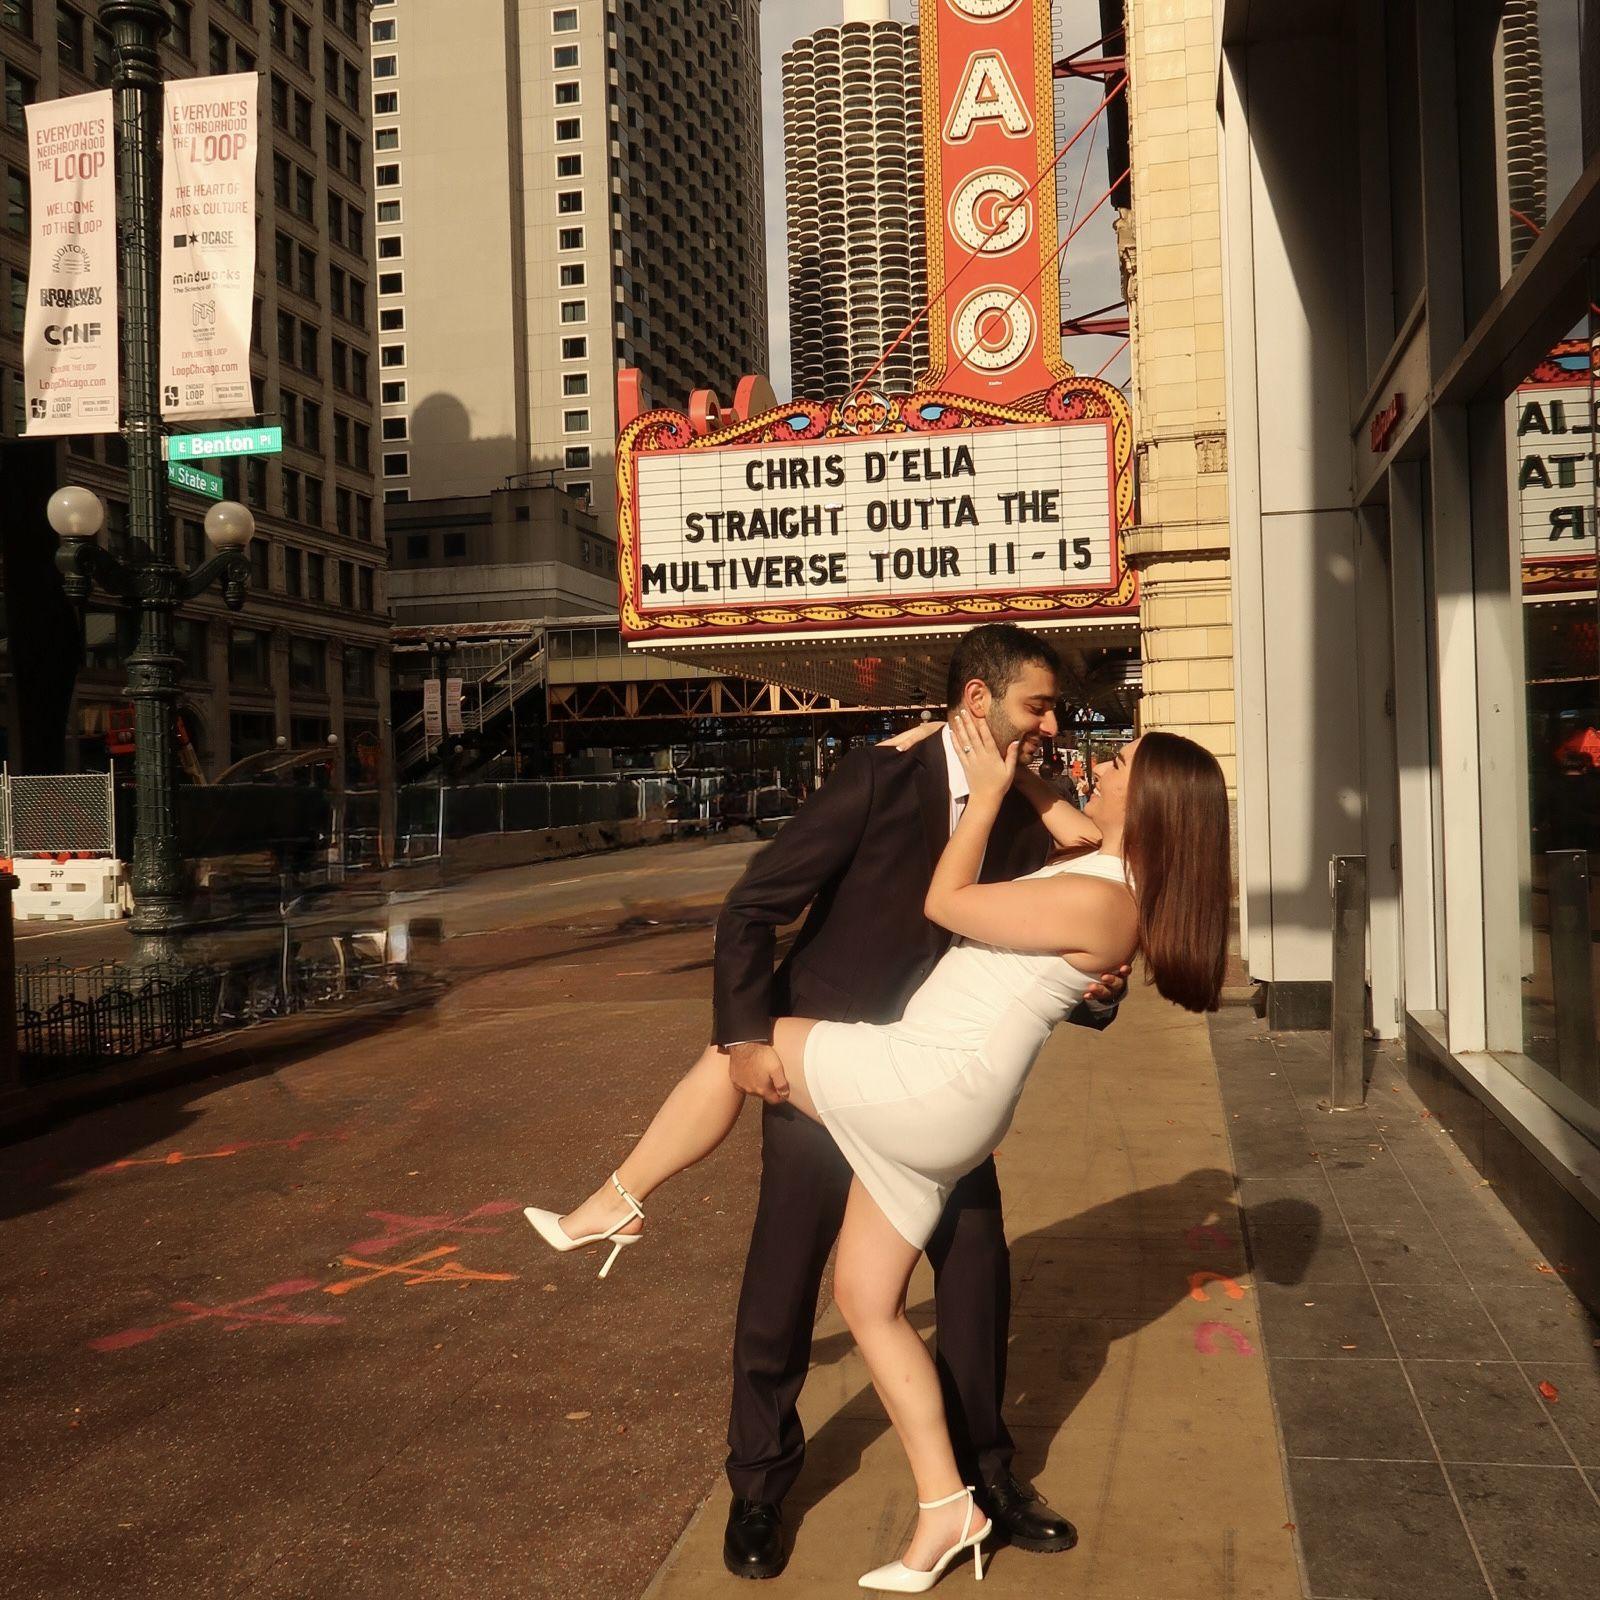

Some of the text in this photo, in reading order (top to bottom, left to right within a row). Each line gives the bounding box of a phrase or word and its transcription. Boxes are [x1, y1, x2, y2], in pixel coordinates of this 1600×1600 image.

[174, 100, 247, 121] EVERYONE'S
[37, 119, 104, 145] EVERYONE'S
[173, 118, 247, 135] NEIGHBORHOOD
[37, 136, 105, 158] NEIGHBORHOOD
[173, 133, 247, 163] THE LOOP
[38, 151, 105, 182] THE LOOP
[176, 182, 240, 199] THE HEART OF
[943, 0, 1037, 375] AGO
[46, 200, 94, 216] WELCOME
[170, 201, 248, 219] ARTS & CULTURE
[42, 220, 102, 236] TO THE LOOP
[201, 231, 234, 245] DCASE
[173, 269, 240, 285] mindworks
[172, 363, 239, 377] LoopChicago.com
[185, 390, 205, 401] LOOP
[52, 403, 72, 413] LOOP
[179, 434, 272, 455] E Benton Pl
[745, 444, 976, 492] CHRIS D'ELIA
[178, 467, 207, 491] State
[685, 488, 1060, 543] STRAIGHT OUTTA THE
[641, 551, 847, 595] MULTIVERSE
[869, 545, 961, 583] TOUR
